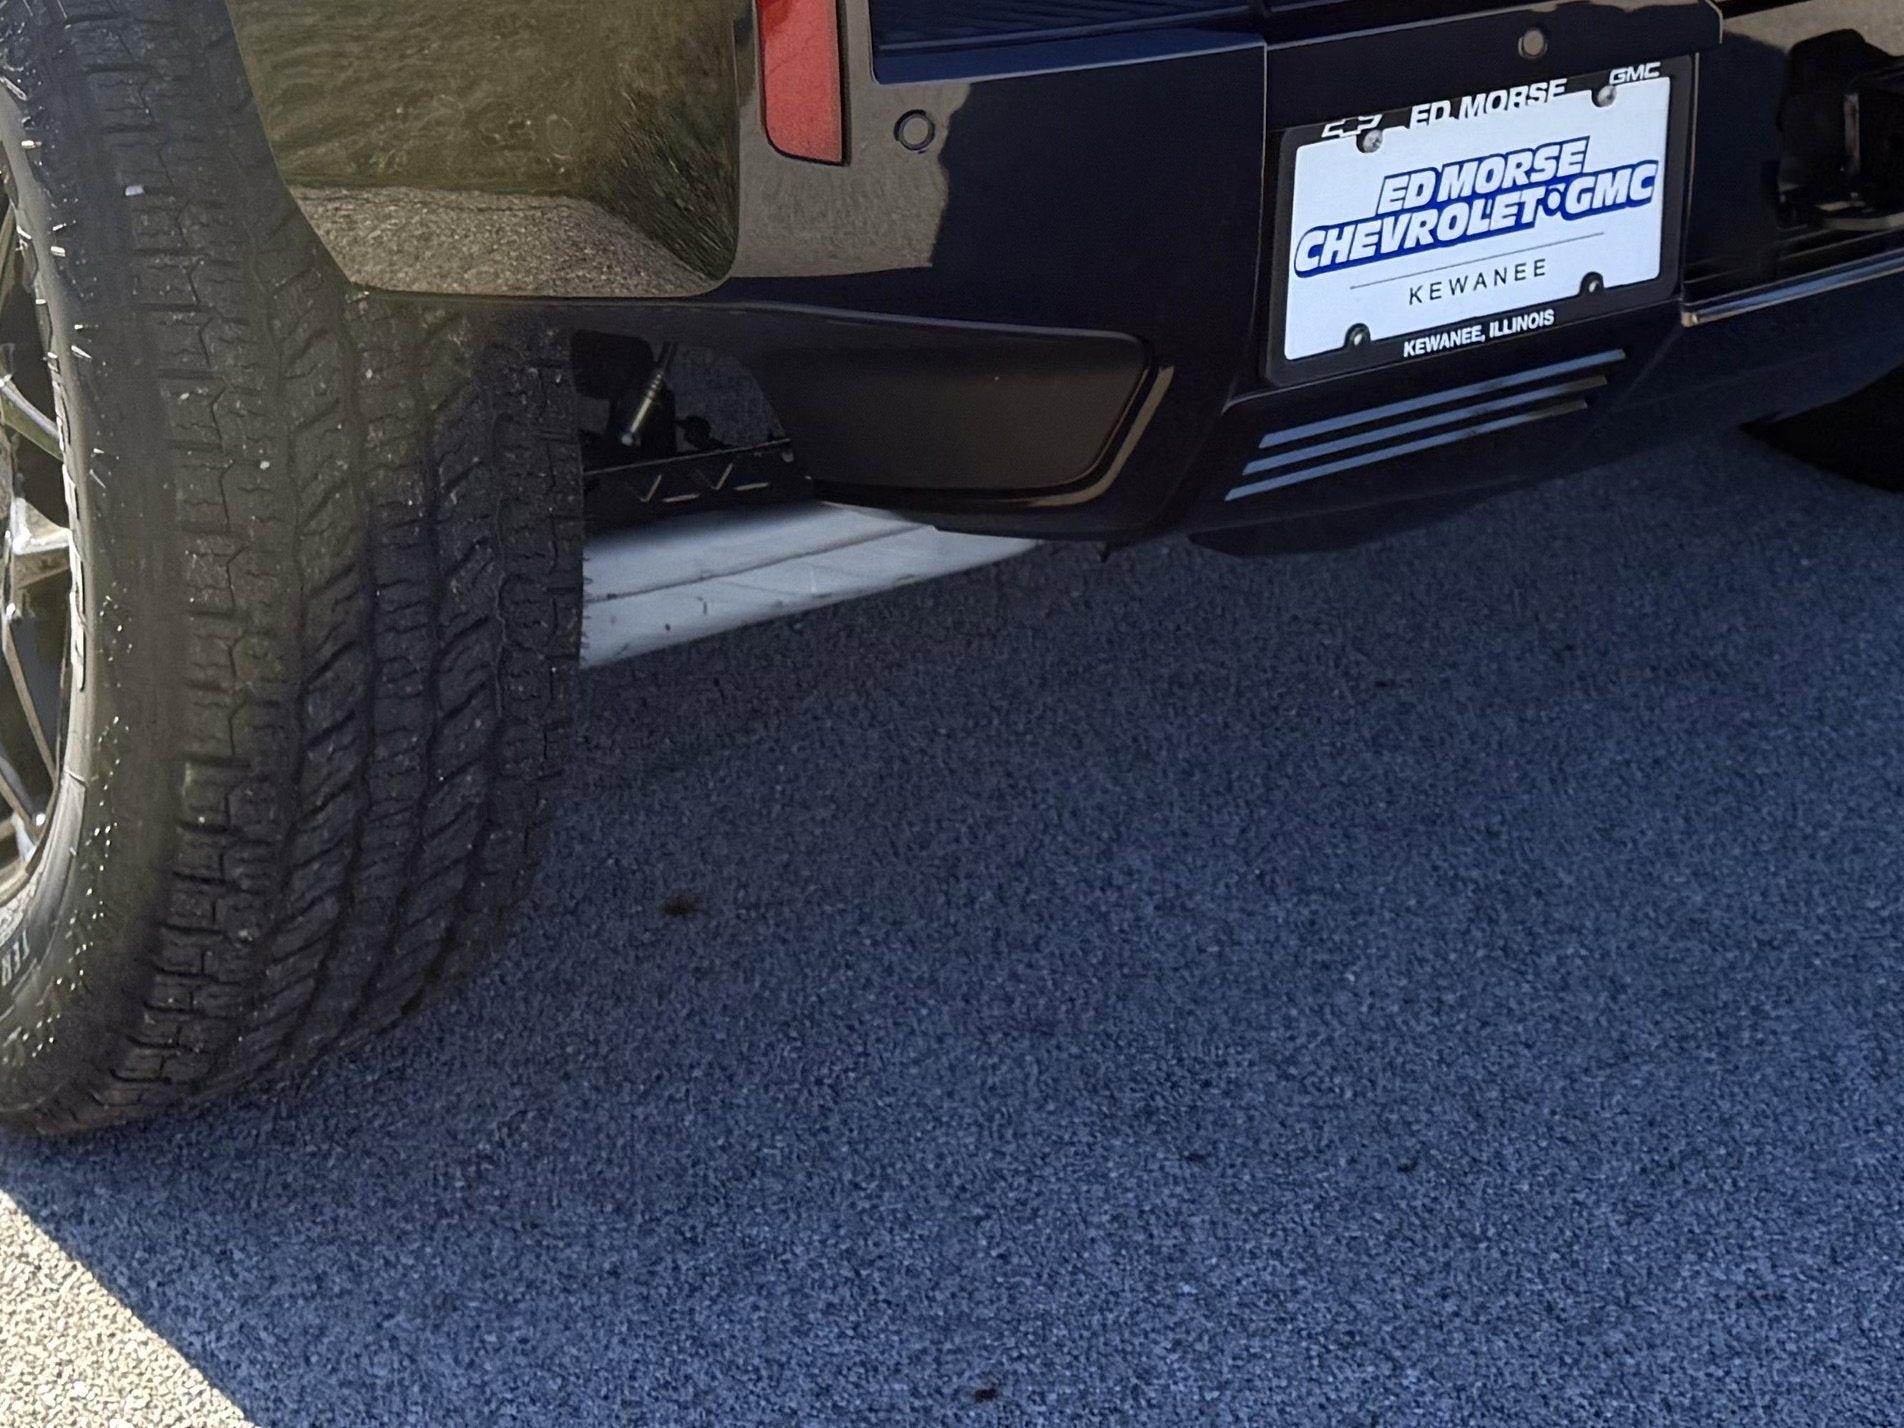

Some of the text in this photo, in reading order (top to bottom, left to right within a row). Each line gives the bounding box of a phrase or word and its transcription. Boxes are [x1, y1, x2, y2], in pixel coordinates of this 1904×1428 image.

[1609, 62, 1660, 85] GMC
[1410, 79, 1567, 129] ED MORSE
[1378, 138, 1587, 215] ED MORSE
[1409, 259, 1547, 305] KEWANEE
[1403, 310, 1554, 358] KEWANEE, ILLINOIS
